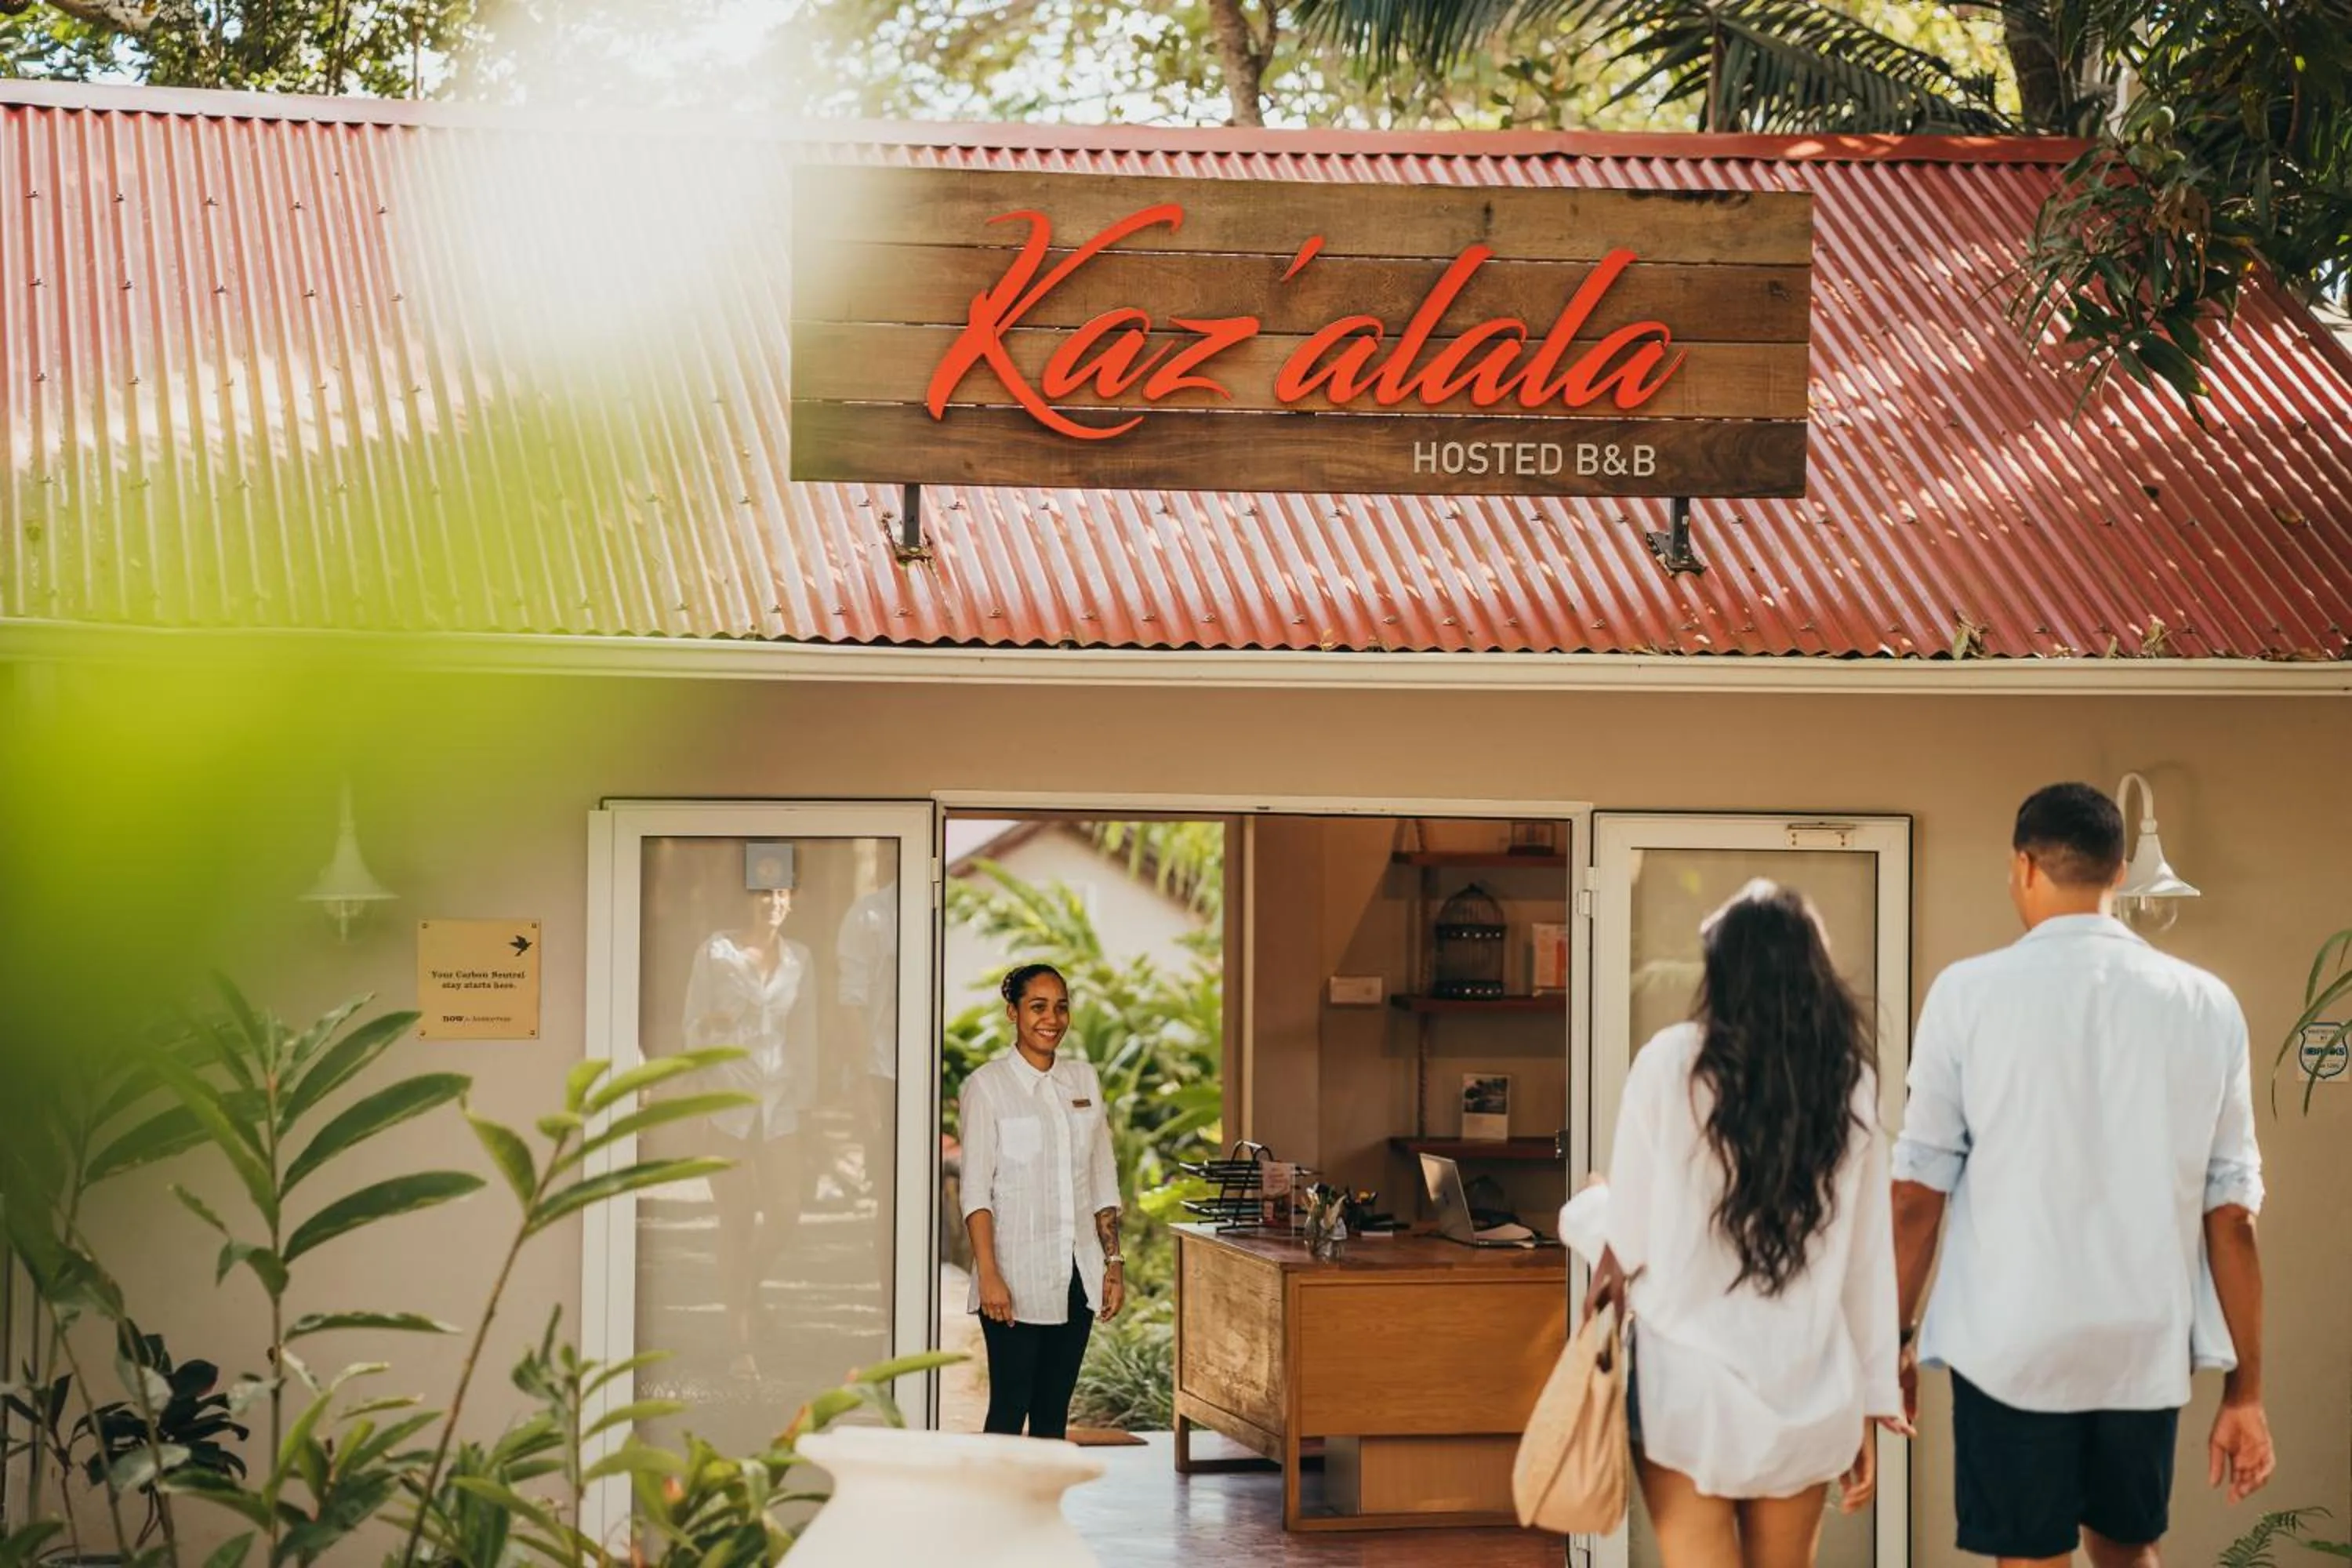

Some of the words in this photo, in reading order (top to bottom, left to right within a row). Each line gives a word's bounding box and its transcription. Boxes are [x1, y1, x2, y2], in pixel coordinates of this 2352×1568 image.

[1413, 441, 1563, 475] HOSTED
[1577, 442, 1657, 477] B&B
[431, 971, 453, 979] Your
[456, 971, 488, 979] Carbon
[492, 971, 525, 979] Neutral
